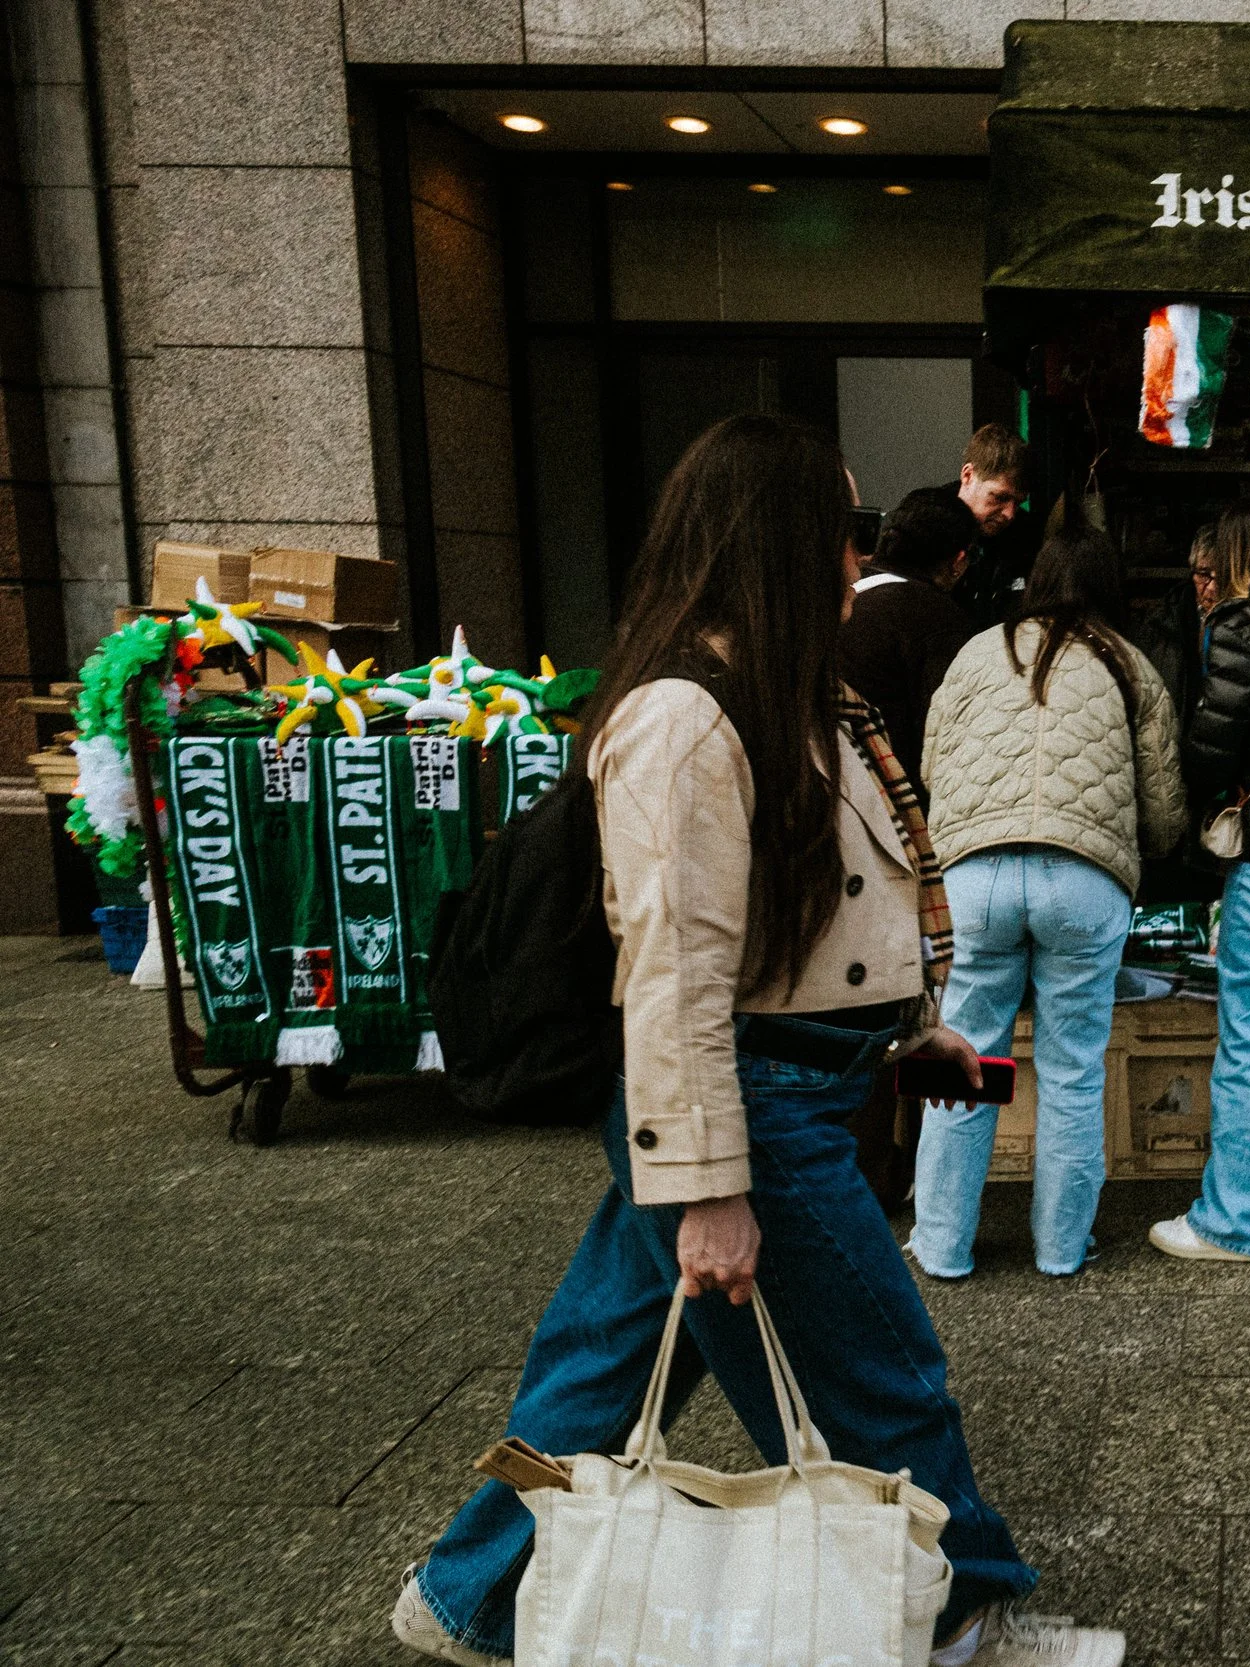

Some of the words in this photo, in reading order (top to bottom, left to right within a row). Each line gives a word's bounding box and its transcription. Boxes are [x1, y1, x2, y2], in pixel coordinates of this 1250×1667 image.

[186, 835, 241, 908] DAY
[347, 973, 400, 989] IRELAND
[654, 1606, 760, 1649] THE
